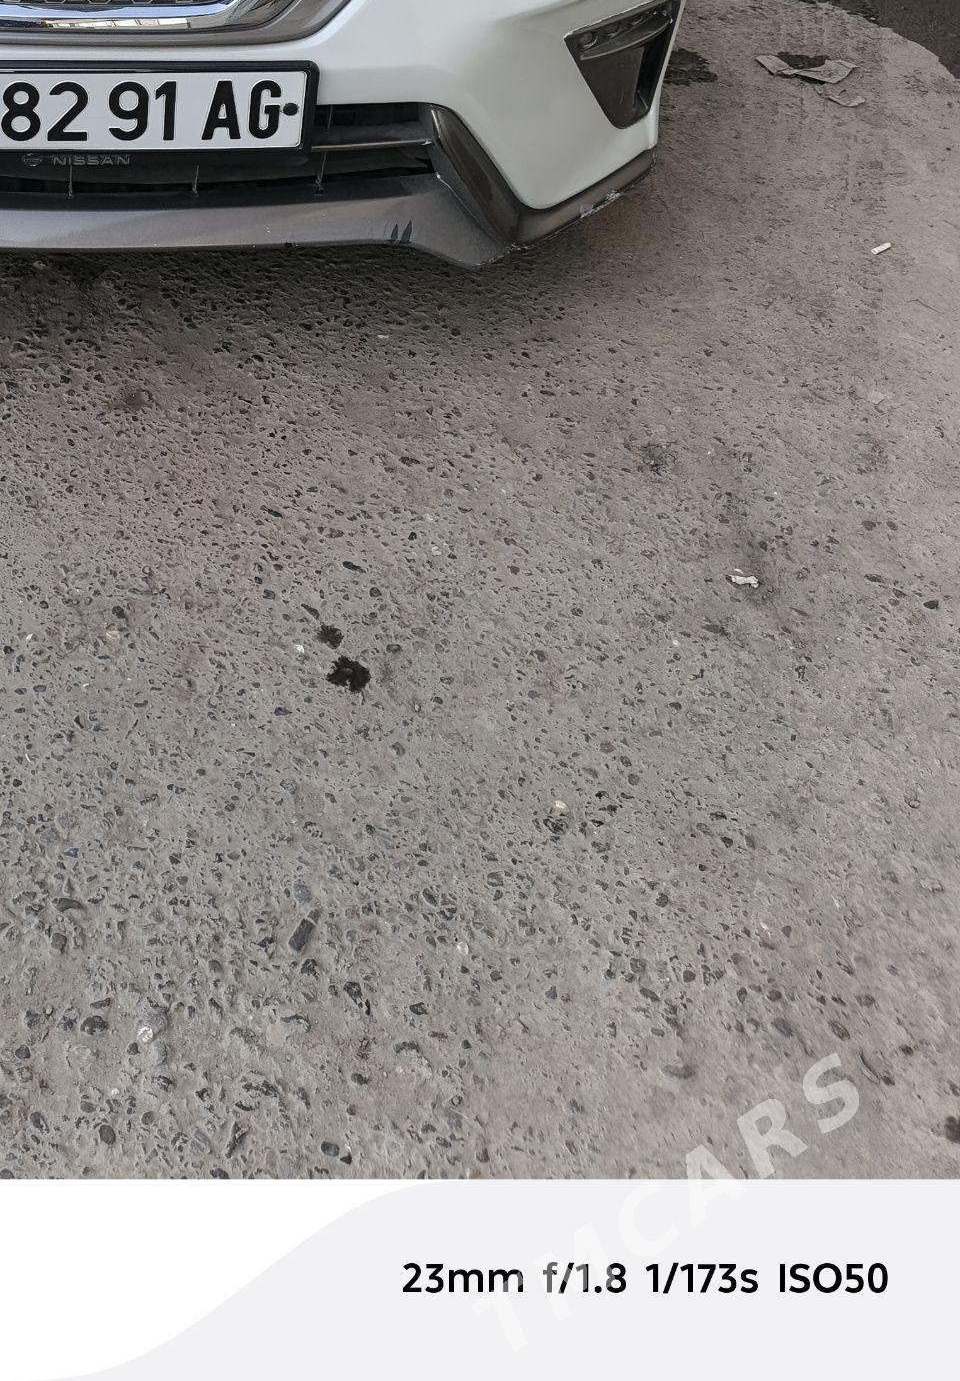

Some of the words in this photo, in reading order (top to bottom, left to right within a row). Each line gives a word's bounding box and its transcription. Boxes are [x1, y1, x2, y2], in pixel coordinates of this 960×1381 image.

[1, 82, 88, 141] 82
[109, 81, 176, 141] 91
[202, 80, 282, 140] AG
[51, 154, 131, 166] NISSAN
